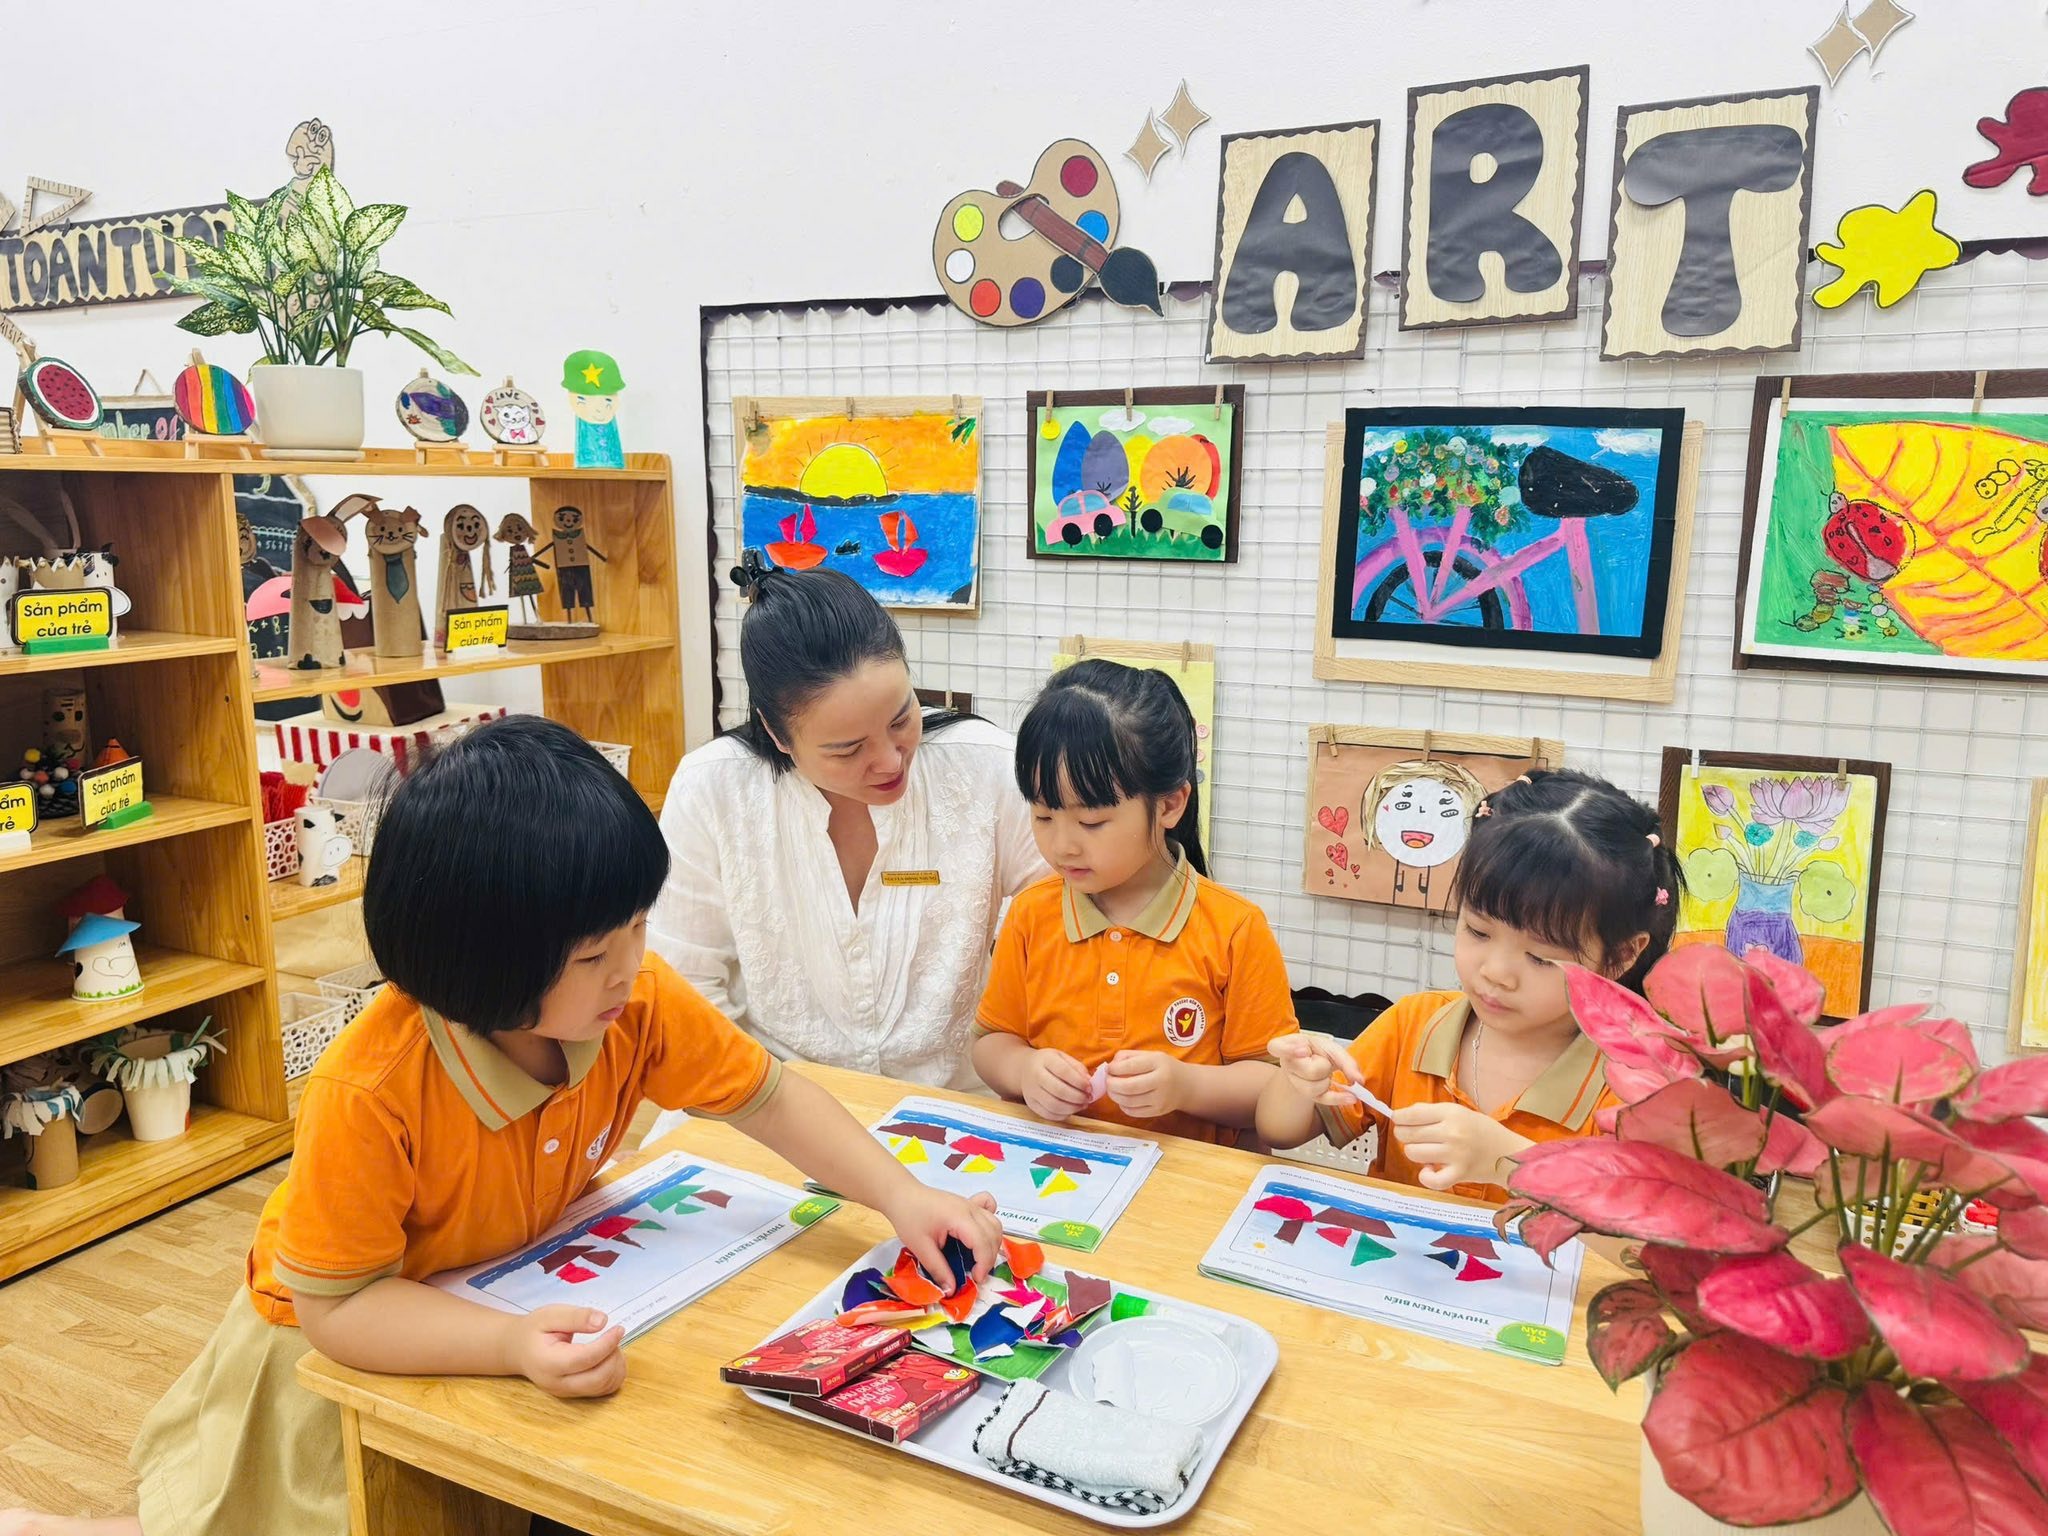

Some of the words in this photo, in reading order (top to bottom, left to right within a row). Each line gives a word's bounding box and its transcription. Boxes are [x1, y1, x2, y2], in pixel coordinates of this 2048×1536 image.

[1221, 102, 1803, 337] ART
[23, 601, 54, 617] Sản
[57, 597, 103, 618] phẩm
[36, 622, 68, 638] của
[71, 619, 92, 635] trẻ
[453, 616, 472, 630] Sản
[474, 613, 503, 631] phẩm
[460, 634, 480, 647] của
[481, 632, 494, 645] trẻ
[92, 779, 109, 796] Sản
[110, 769, 136, 792] phẩm
[100, 799, 118, 816] của
[118, 793, 130, 809] trẻ
